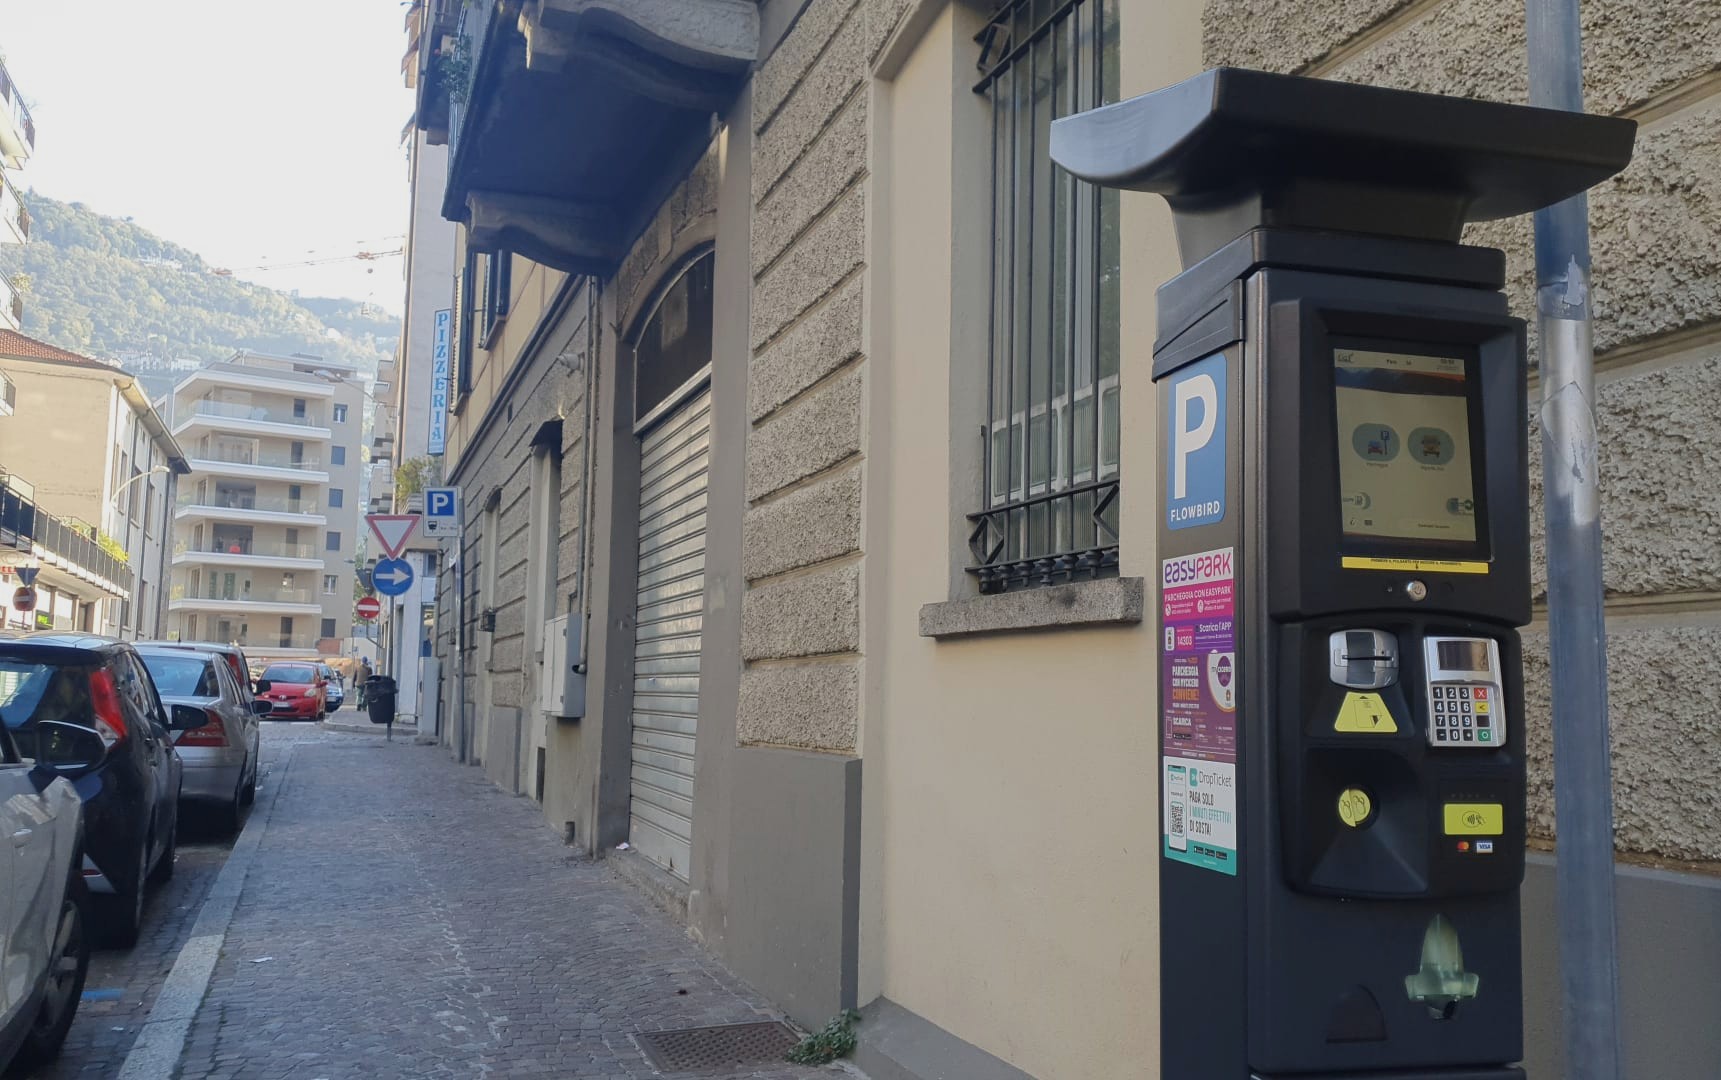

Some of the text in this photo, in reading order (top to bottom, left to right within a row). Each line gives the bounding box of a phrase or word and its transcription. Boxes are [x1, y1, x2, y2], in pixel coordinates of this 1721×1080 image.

[432, 313, 448, 441] PIZZERIA
[1174, 373, 1218, 500] P
[432, 493, 449, 514] P
[1170, 500, 1220, 522] FLOWBIRD
[1164, 585, 1231, 602] PARCHEGGIA CON EASYPARK
[1199, 623, 1219, 632] Scarica
[1177, 635, 1192, 646] 14303
[1435, 688, 1468, 697] 1 2 3
[1436, 702, 1469, 711] 4 5 6
[1437, 716, 1470, 725] 7 8 9
[1452, 730, 1458, 740] 0
[1199, 771, 1232, 788] DropTicket
[1189, 790, 1201, 804] PAGA
[1202, 792, 1214, 806] SOLO
[1192, 806, 1208, 820] MINUTI
[1189, 820, 1212, 836] DI SOSTA!
